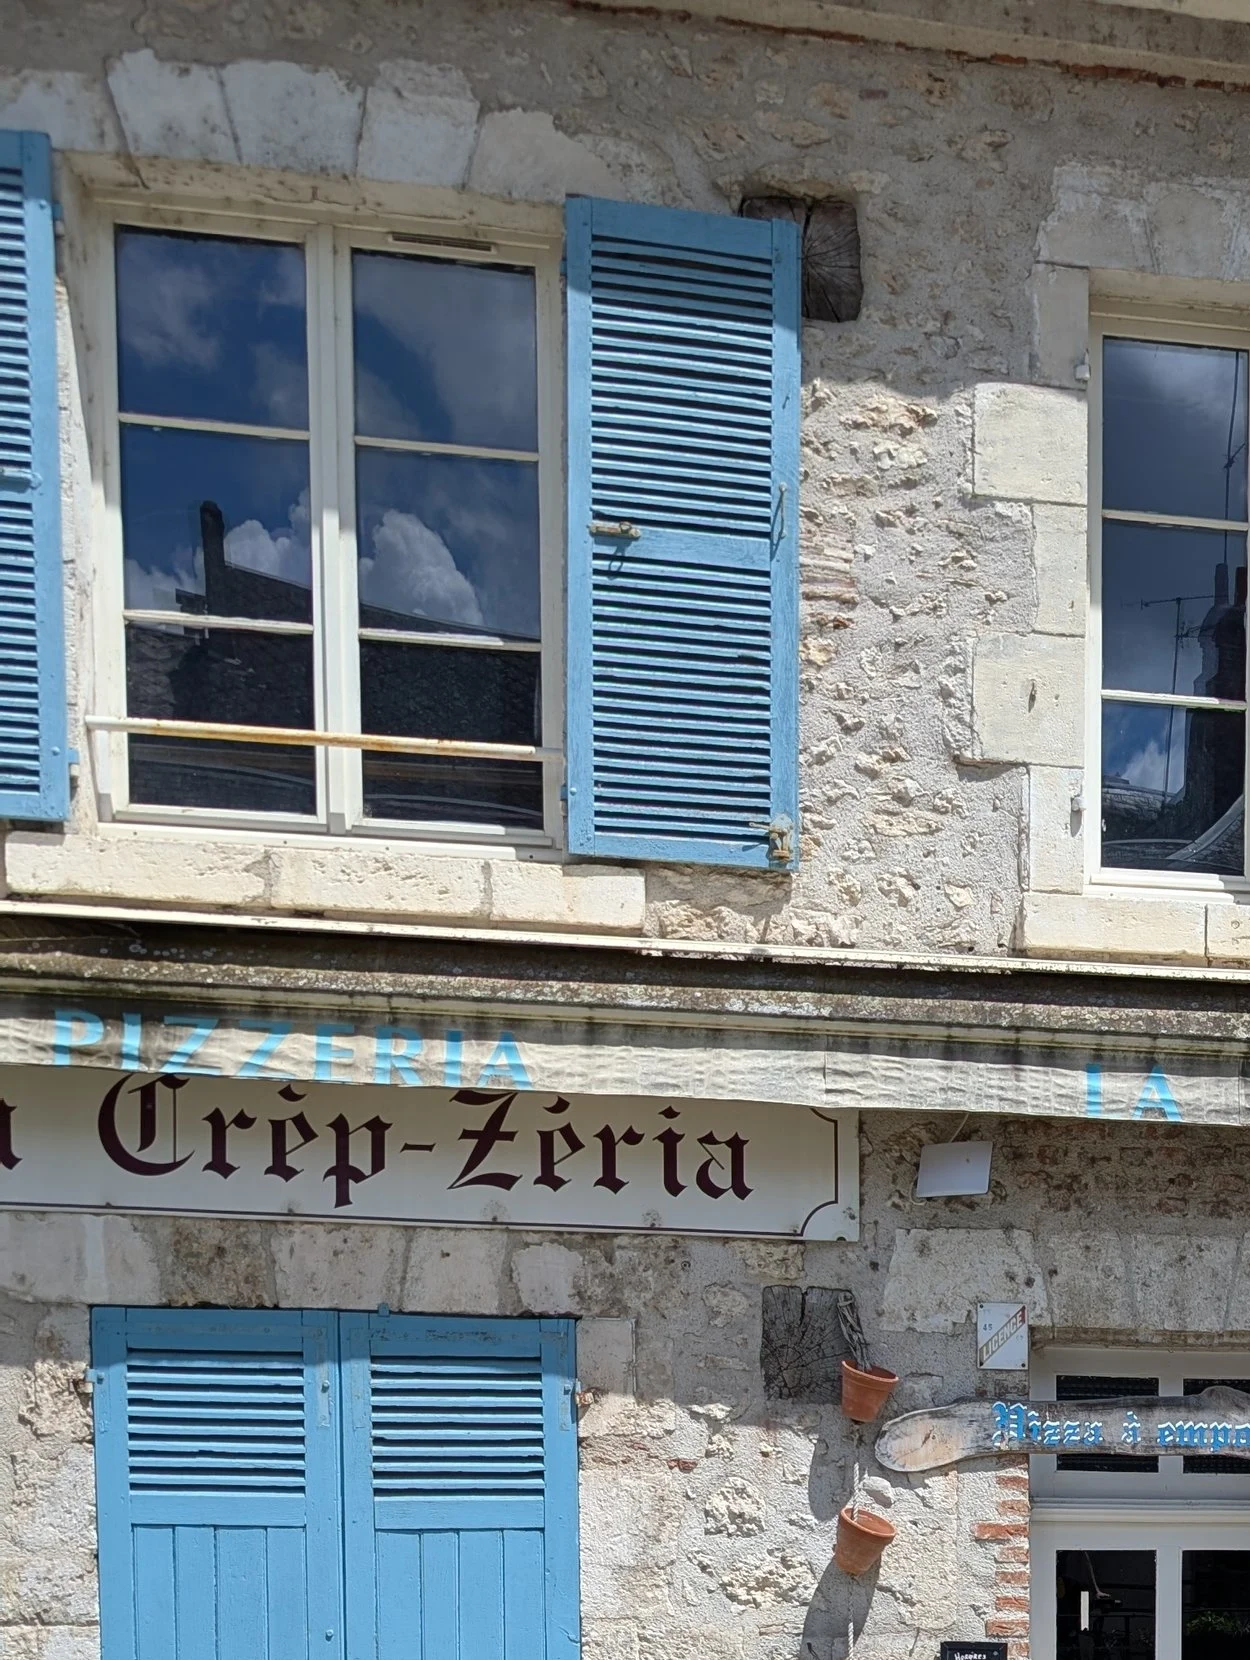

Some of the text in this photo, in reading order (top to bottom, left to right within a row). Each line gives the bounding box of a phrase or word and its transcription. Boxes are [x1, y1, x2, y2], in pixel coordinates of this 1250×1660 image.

[53, 1007, 534, 1091] PIZZERIA
[1085, 1063, 1183, 1123] LA
[982, 1310, 1023, 1362] LICENCE
[991, 1401, 1104, 1450] Pizza
[1121, 1411, 1141, 1445] à
